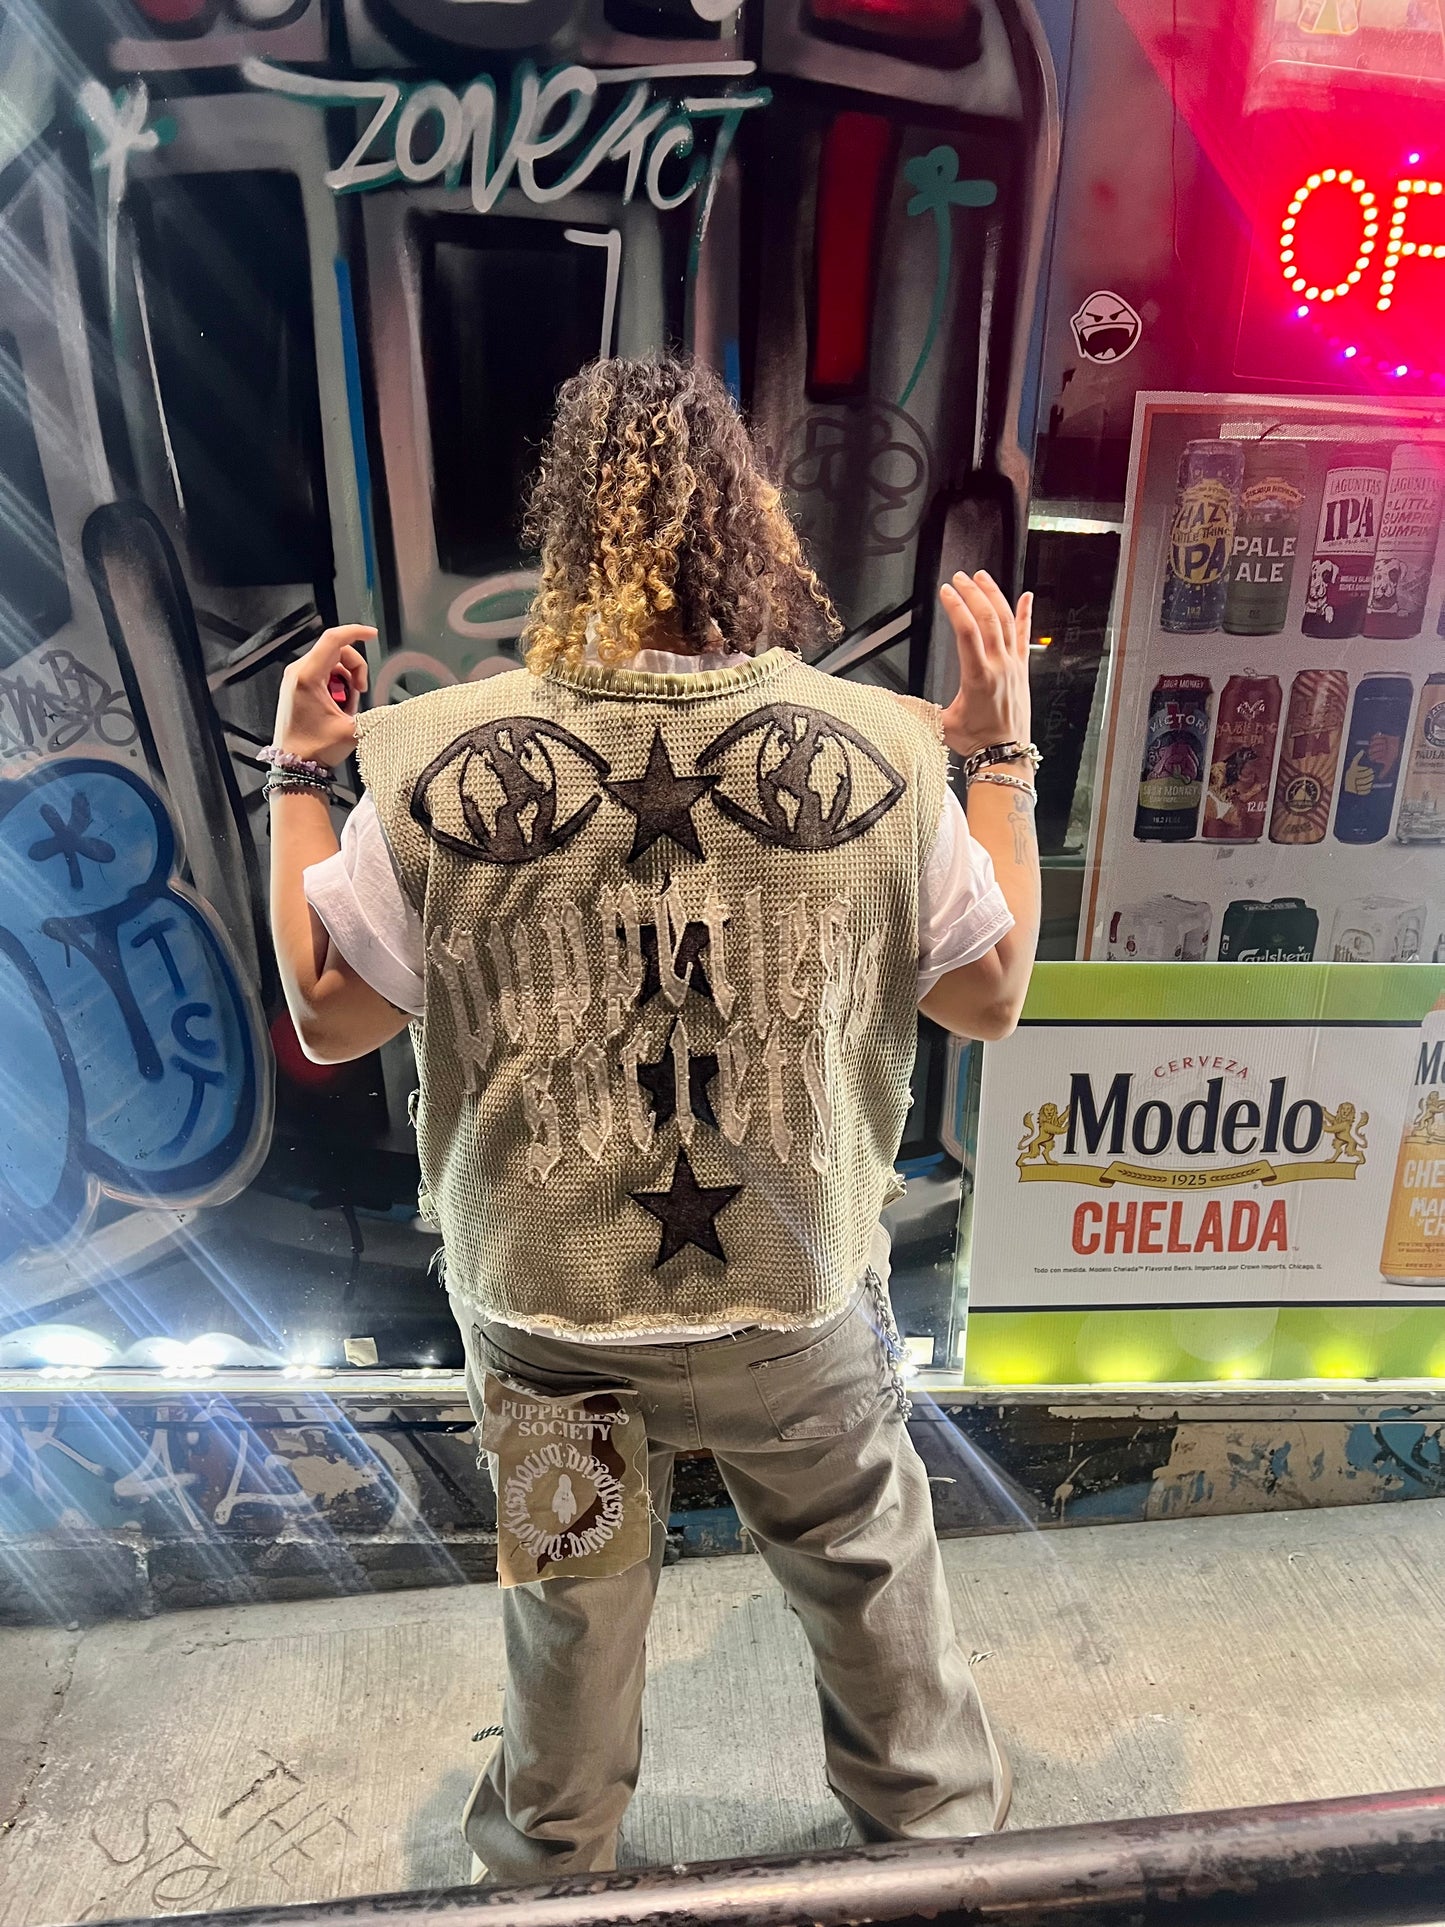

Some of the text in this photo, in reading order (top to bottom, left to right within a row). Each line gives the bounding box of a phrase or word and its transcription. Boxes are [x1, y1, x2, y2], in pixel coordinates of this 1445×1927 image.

[1175, 501, 1230, 529] HAZY
[1323, 497, 1374, 543] IPA
[1171, 537, 1227, 579] IPA
[1231, 535, 1297, 557] PALE
[1234, 562, 1285, 583] ALE
[1150, 712, 1210, 736] VICTORY
[1154, 1056, 1250, 1079] CERVEZA
[1062, 1072, 1325, 1156] Modelo
[1171, 1173, 1207, 1187] 1925
[1071, 1199, 1288, 1256] CHELADA
[501, 1399, 630, 1426] PUPPETLESS
[518, 1419, 612, 1441] SOCIETY
